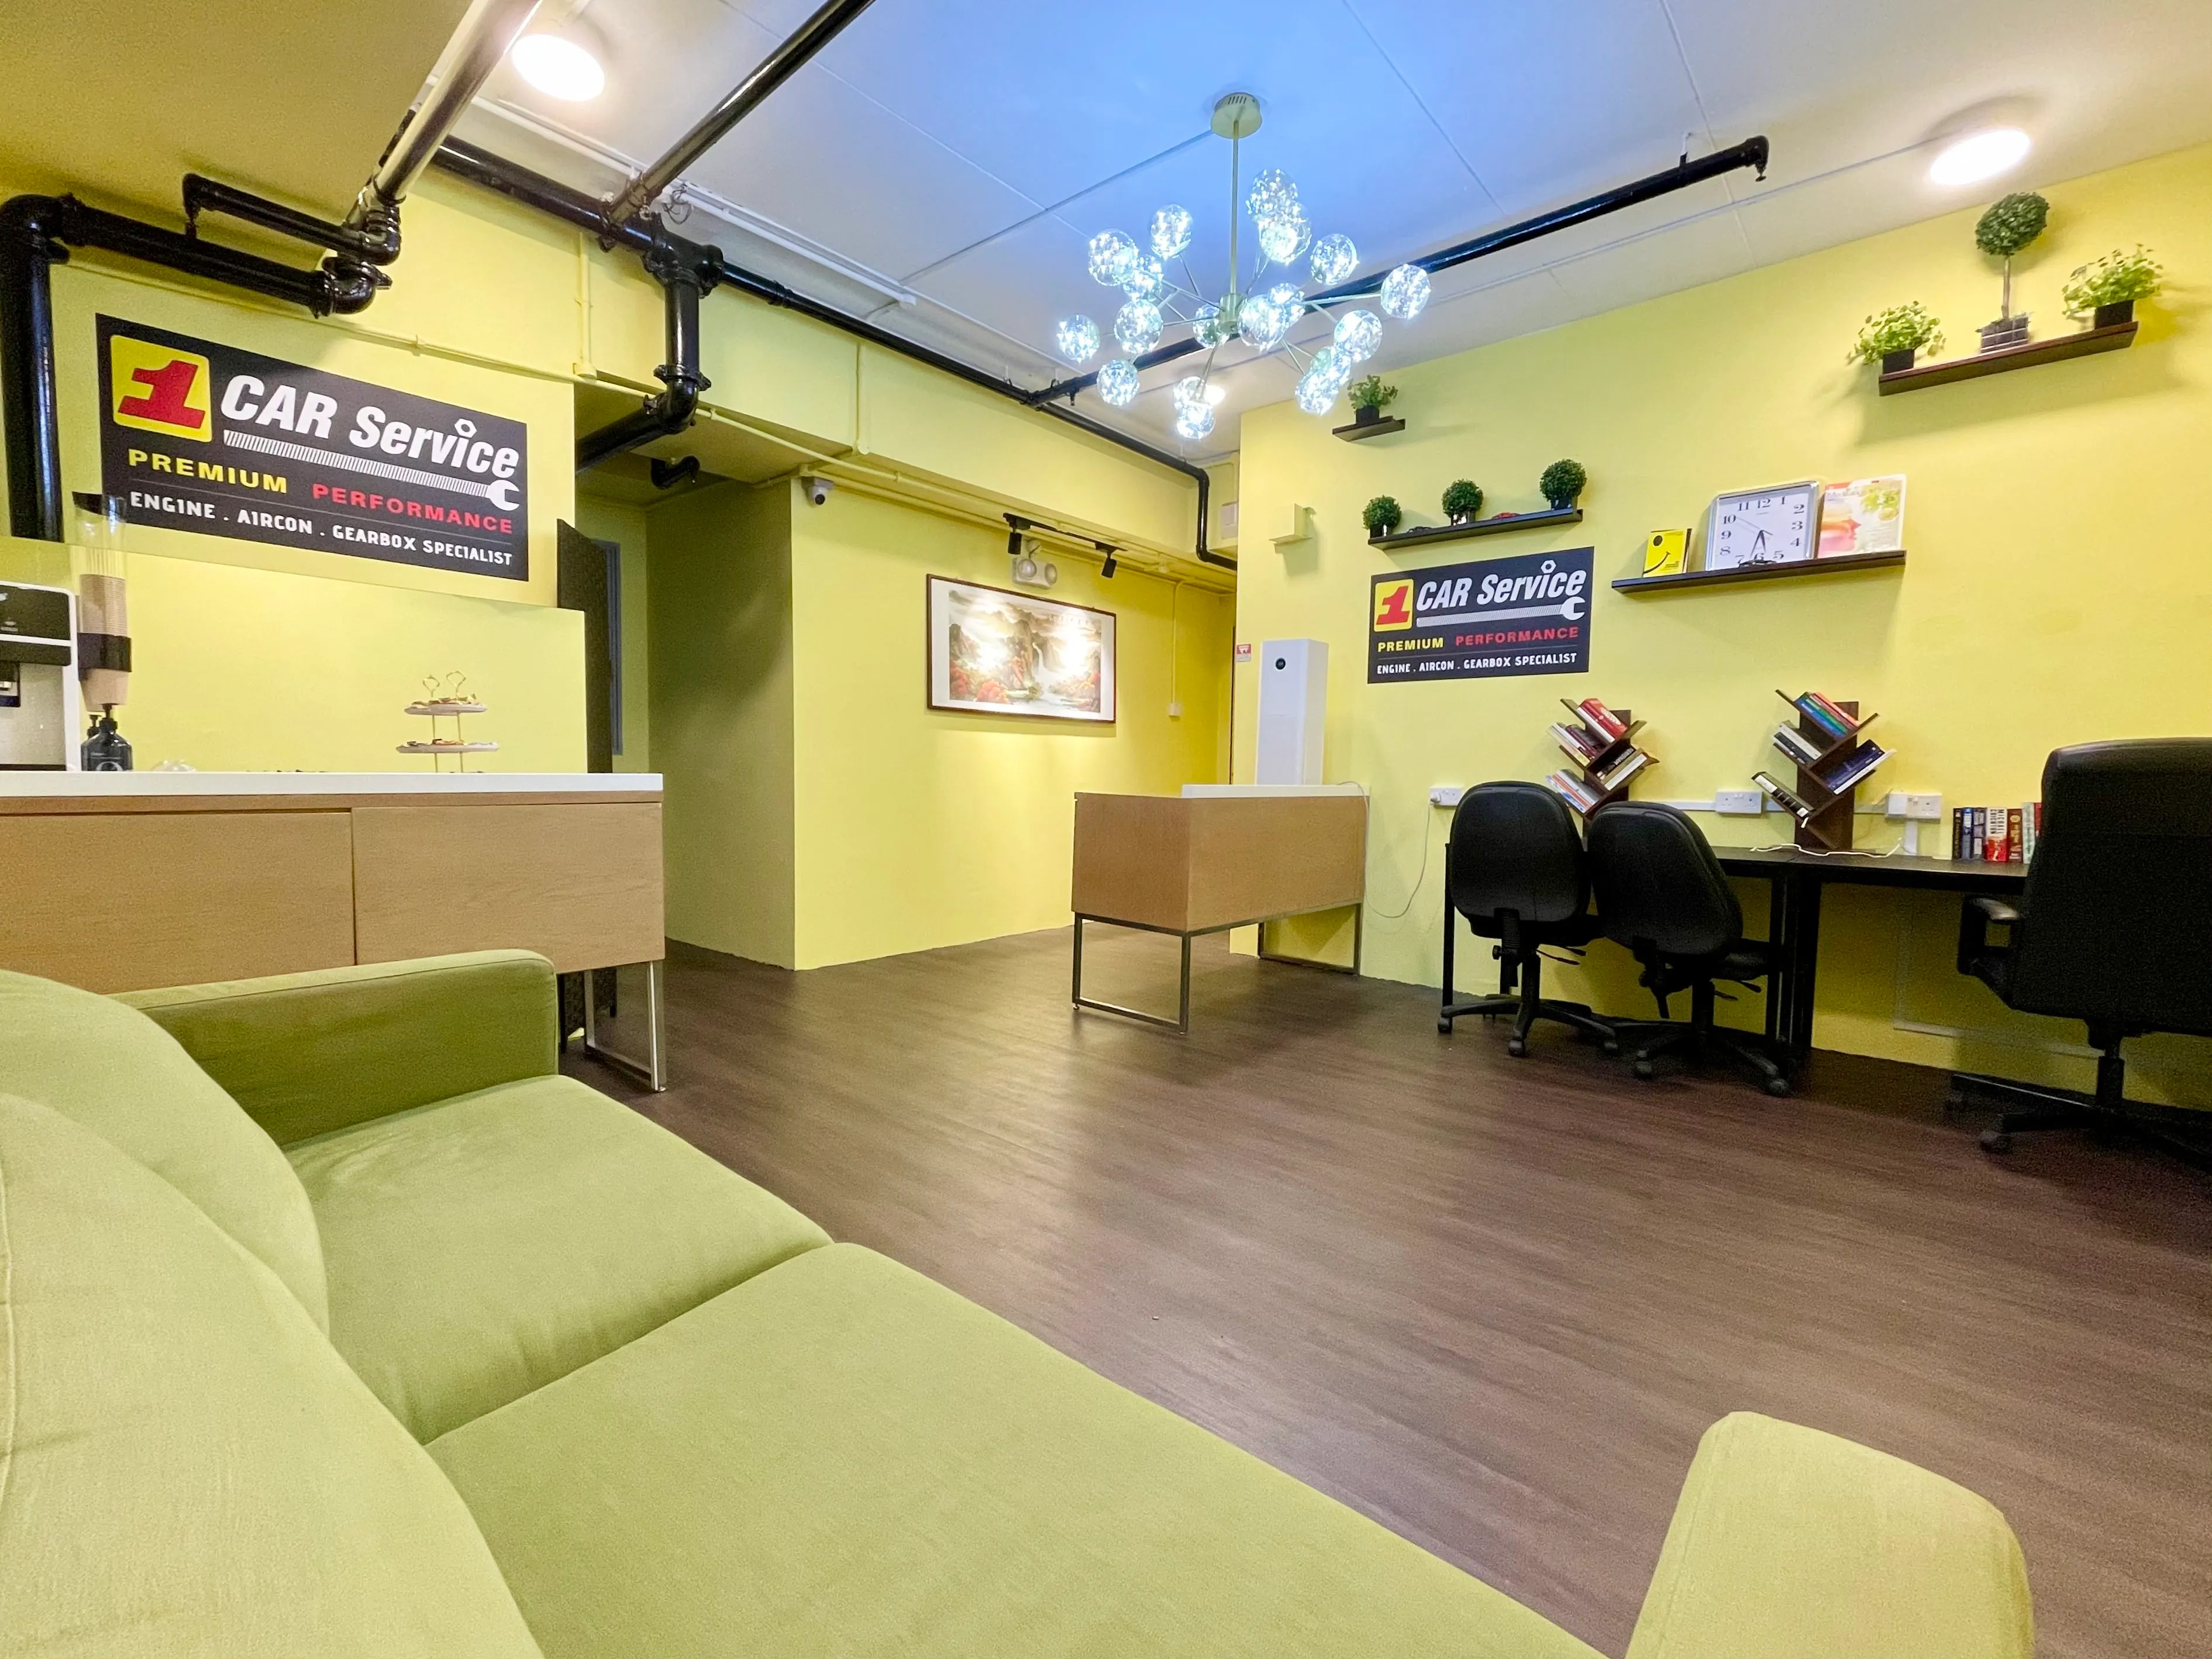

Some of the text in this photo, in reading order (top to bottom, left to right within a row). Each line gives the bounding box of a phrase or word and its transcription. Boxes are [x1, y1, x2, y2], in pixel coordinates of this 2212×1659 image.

[119, 360, 519, 479] 1 CAR Service
[128, 449, 513, 534] PREMIUM PERFORMANCE
[1738, 501, 1750, 511] 11
[1757, 498, 1771, 508] 12
[1793, 504, 1804, 514] 2
[1722, 515, 1736, 524] 10
[130, 491, 512, 566] ENGINE AIRCON GEARBOX SPECIALIST
[1791, 521, 1803, 530] 3
[1721, 531, 1732, 539] 9
[1790, 538, 1801, 547] 4
[1720, 546, 1731, 556] 8
[1773, 550, 1784, 560] 5
[1735, 555, 1745, 564] 7
[1376, 560, 1587, 625] 1 CAR Service
[1378, 627, 1579, 652] PREMIUM PERFORMANCE
[1377, 653, 1577, 674] ENGINE AIRCON GEARBOX SPECIALIST
